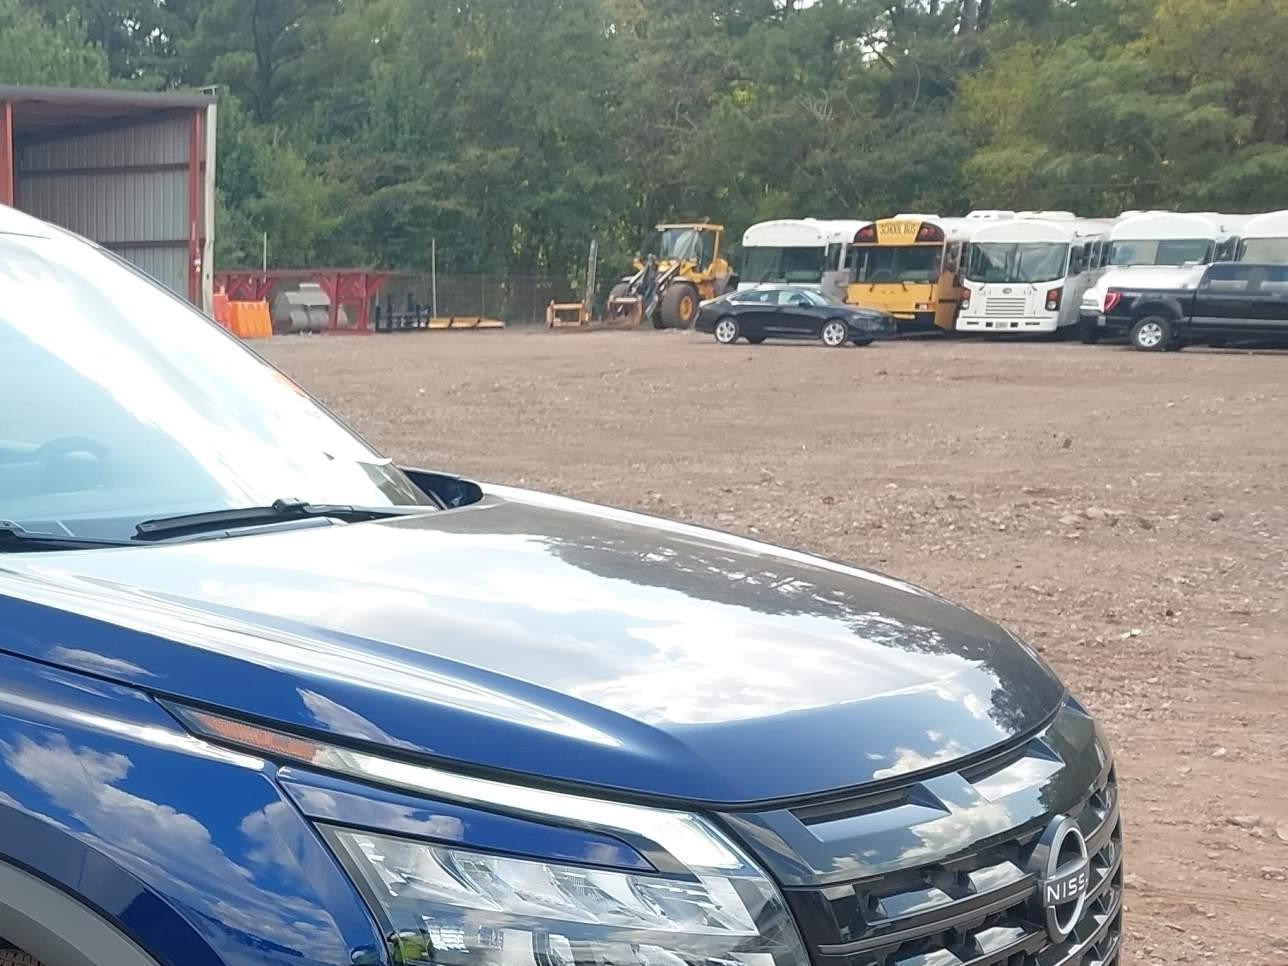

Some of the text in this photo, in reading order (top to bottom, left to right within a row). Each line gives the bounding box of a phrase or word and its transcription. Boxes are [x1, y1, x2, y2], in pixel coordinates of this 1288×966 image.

[880, 222, 916, 235] SCHOOL BUS
[1047, 872, 1088, 902] NISS
